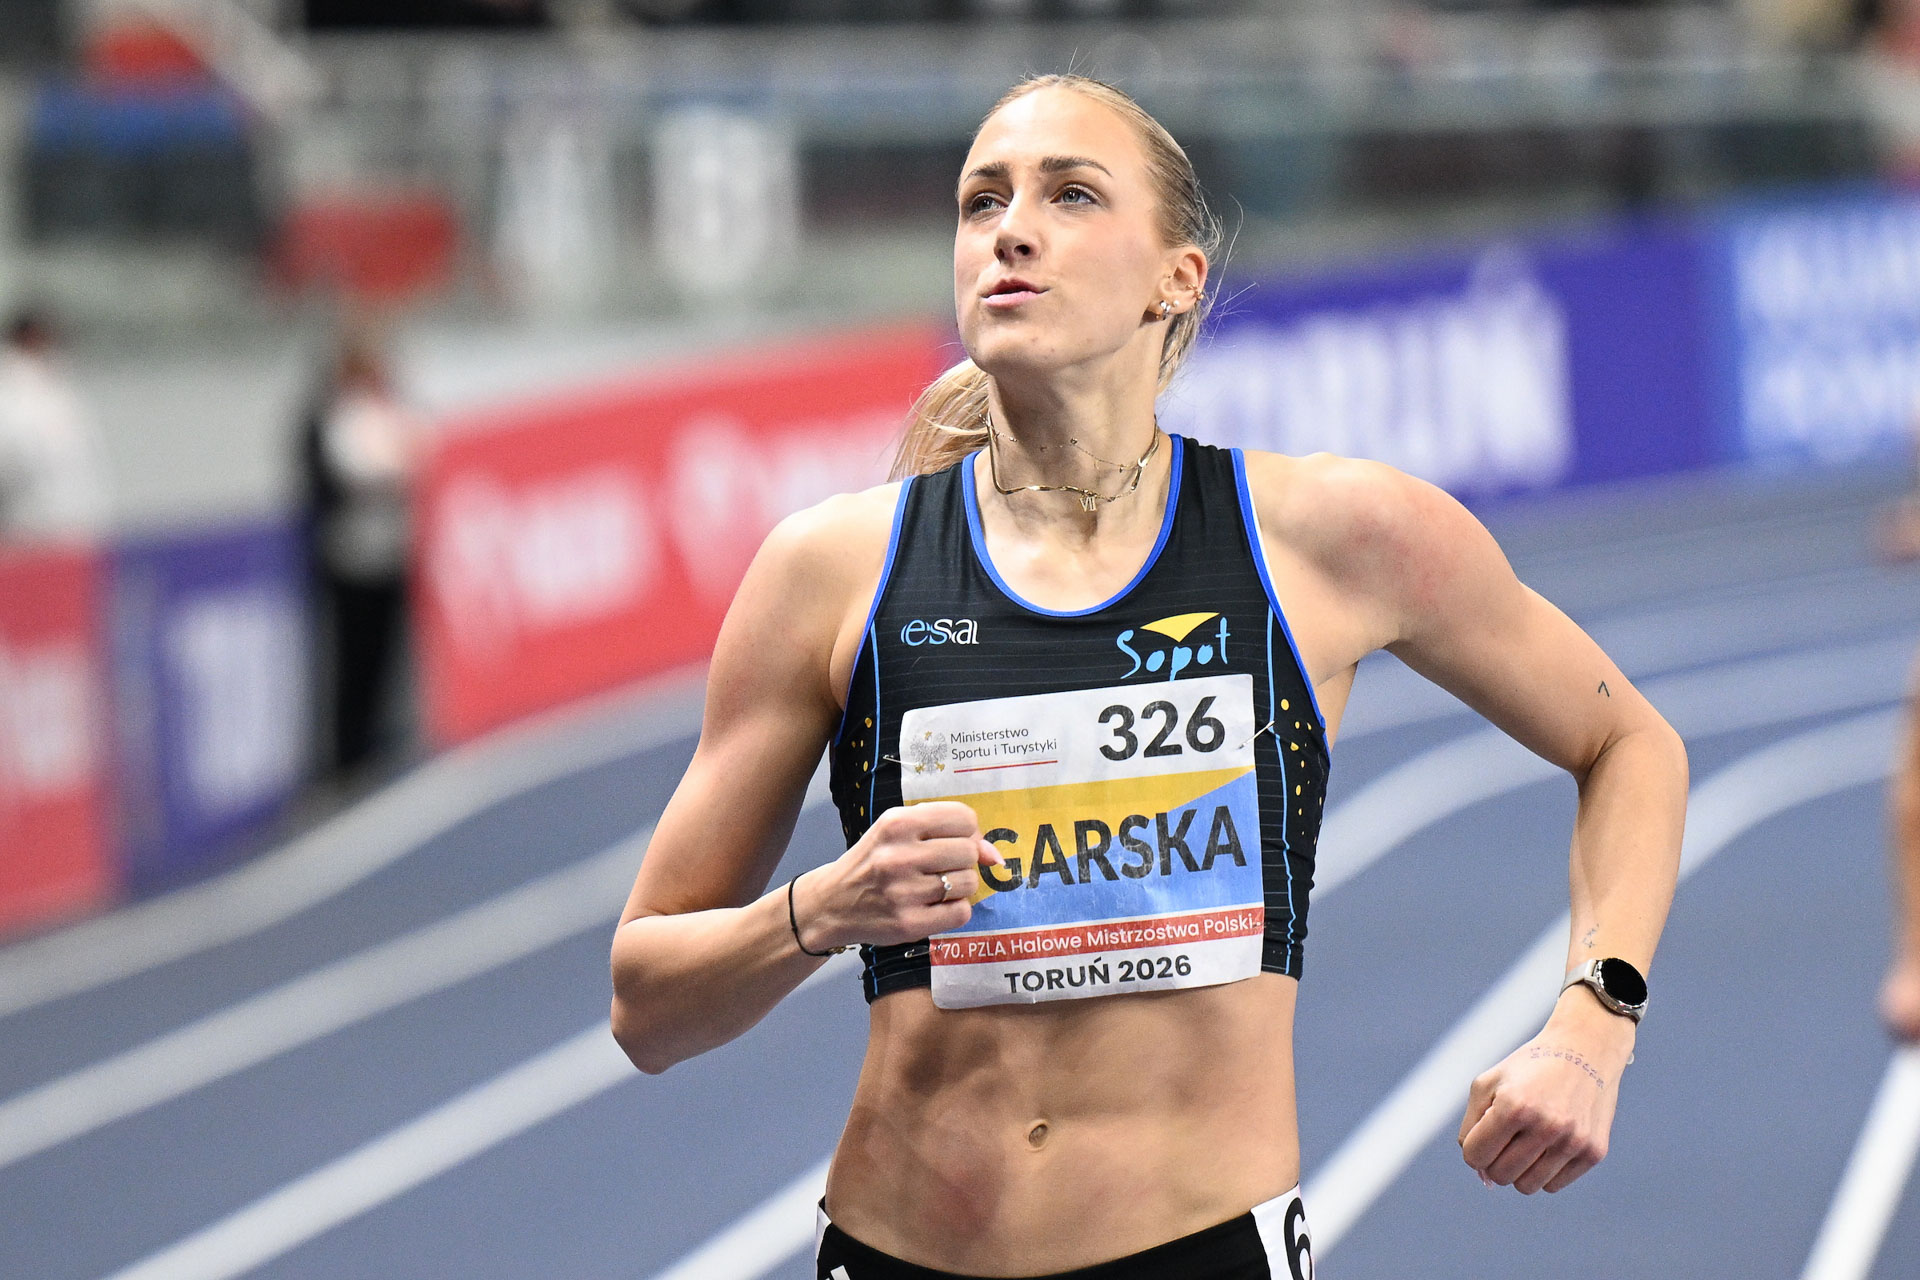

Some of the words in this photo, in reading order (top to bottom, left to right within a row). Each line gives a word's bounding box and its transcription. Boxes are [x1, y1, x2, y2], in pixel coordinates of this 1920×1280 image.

[1116, 616, 1231, 682] Sopot
[950, 728, 1029, 744] Ministerstwo
[951, 747, 991, 761] Sportu
[994, 744, 998, 756] i
[1001, 738, 1058, 755] Turystyki
[1097, 695, 1226, 761] 326
[942, 942, 964, 959] 70.
[968, 941, 1007, 957] PZLA
[1010, 935, 1082, 954] Halowe
[1087, 923, 1200, 947] Mistrzostwa
[1204, 913, 1254, 935] Polski
[1004, 956, 1111, 994] TORUŃ
[1118, 954, 1192, 983] 2026
[1283, 1196, 1313, 1280] 6
